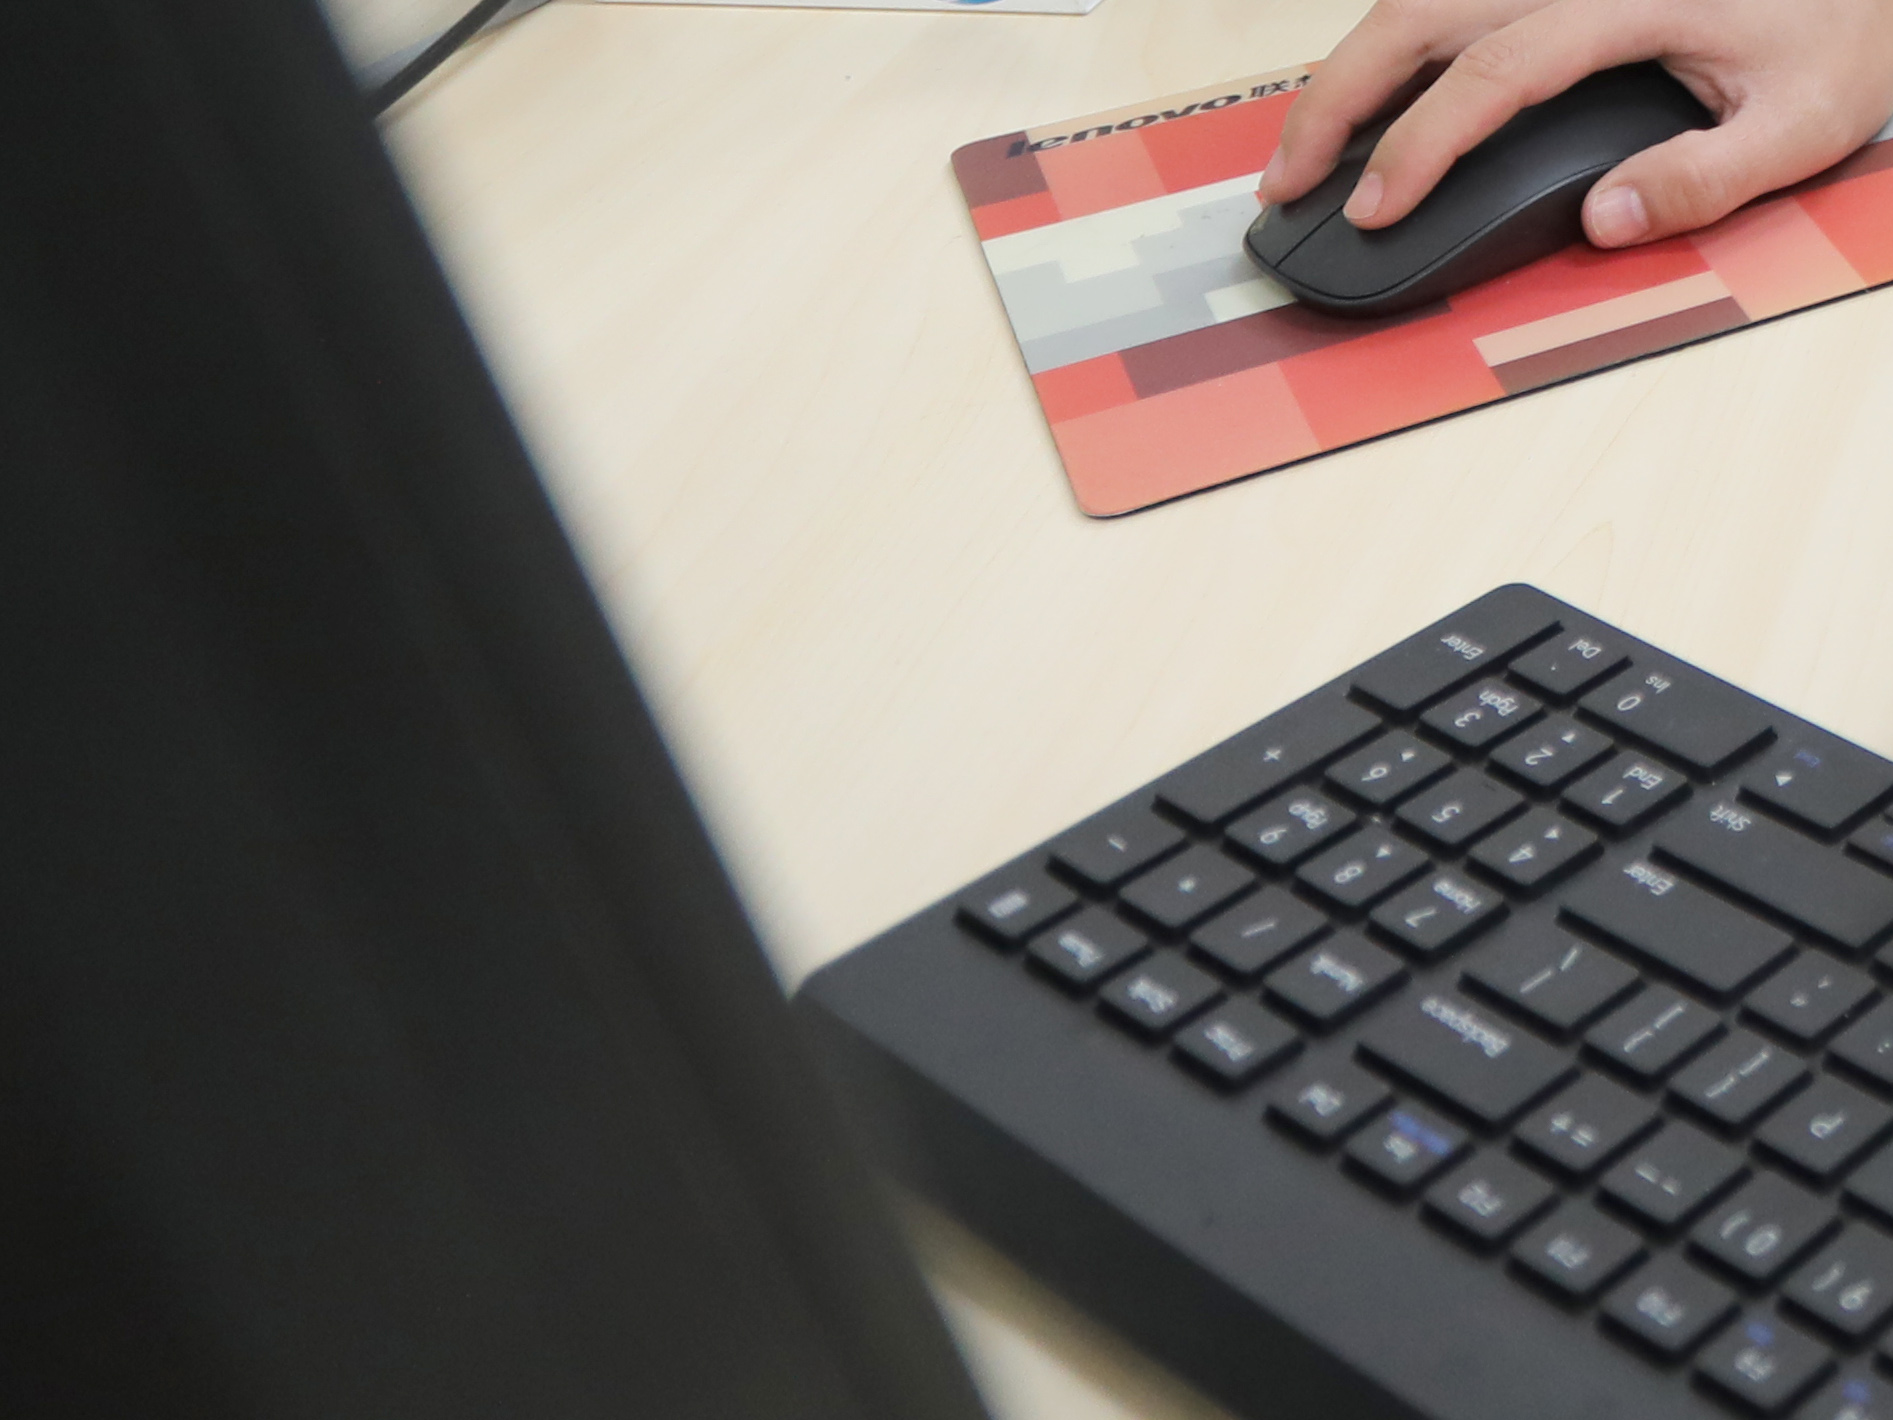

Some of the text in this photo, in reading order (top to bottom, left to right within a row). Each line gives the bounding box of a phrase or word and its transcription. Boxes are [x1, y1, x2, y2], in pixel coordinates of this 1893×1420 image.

[1006, 93, 1243, 158] lenovo
[1440, 632, 1484, 661] Enter
[1566, 637, 1601, 660] Del
[1645, 673, 1673, 695] Ins
[1453, 709, 1482, 729] 3
[1523, 745, 1556, 766] 2
[1622, 764, 1665, 791] End
[1429, 800, 1462, 823] 5
[1708, 801, 1753, 833] Shift
[1259, 825, 1289, 845] 9
[1332, 862, 1366, 885] 8
[1621, 861, 1679, 898] Enter
[1430, 878, 1483, 914] Home
[1403, 903, 1439, 930] 7
[1420, 995, 1511, 1059] Backspace
[1809, 1111, 1846, 1139] P
